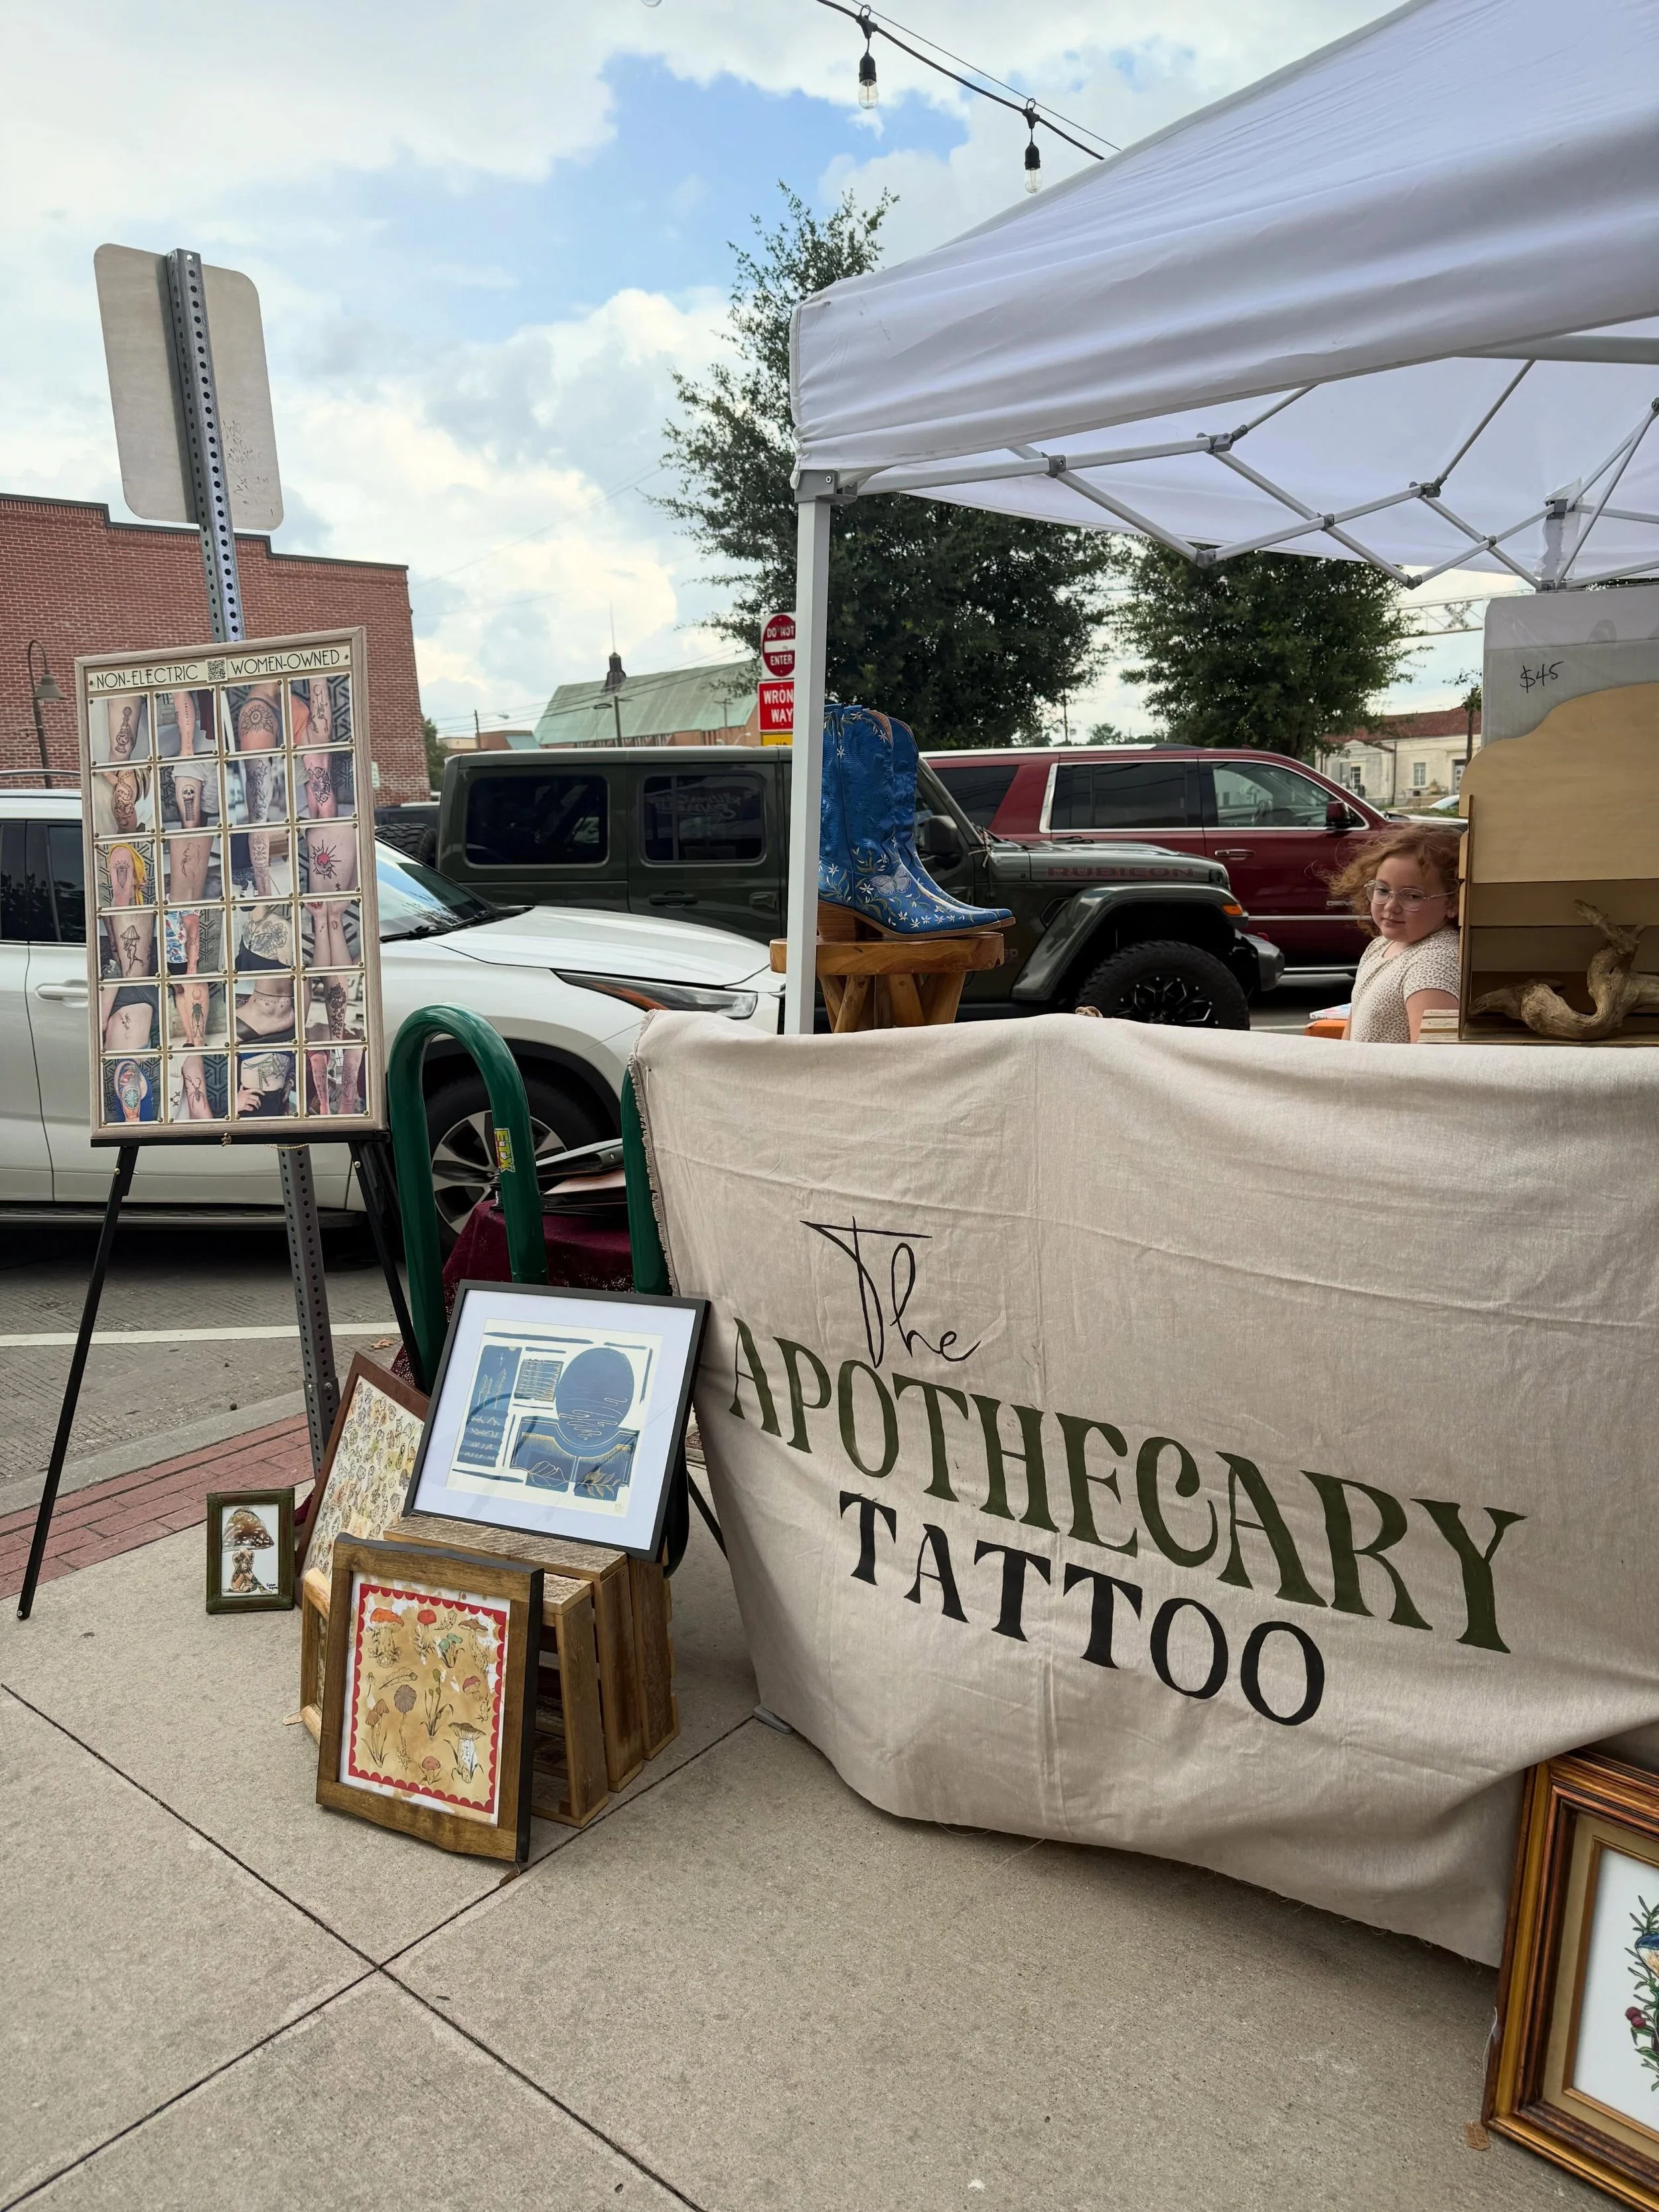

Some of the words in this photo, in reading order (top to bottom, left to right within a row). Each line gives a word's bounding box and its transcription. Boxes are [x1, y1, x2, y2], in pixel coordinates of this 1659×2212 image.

[766, 627, 777, 638] DO
[780, 626, 795, 637] NOT
[96, 664, 198, 689] NON-ELECTRIC
[230, 650, 340, 675] WOMEN-OWNED
[770, 655, 793, 666] ENTER
[1520, 661, 1564, 694] $45
[763, 689, 794, 704] WRON
[770, 708, 793, 723] WAY
[1046, 866, 1195, 879] RUBICON
[496, 1130, 514, 1171] ETX
[799, 1216, 981, 1369] The
[729, 1317, 1529, 1654] APOTHECARY
[839, 1490, 1326, 1726] TATTOO
